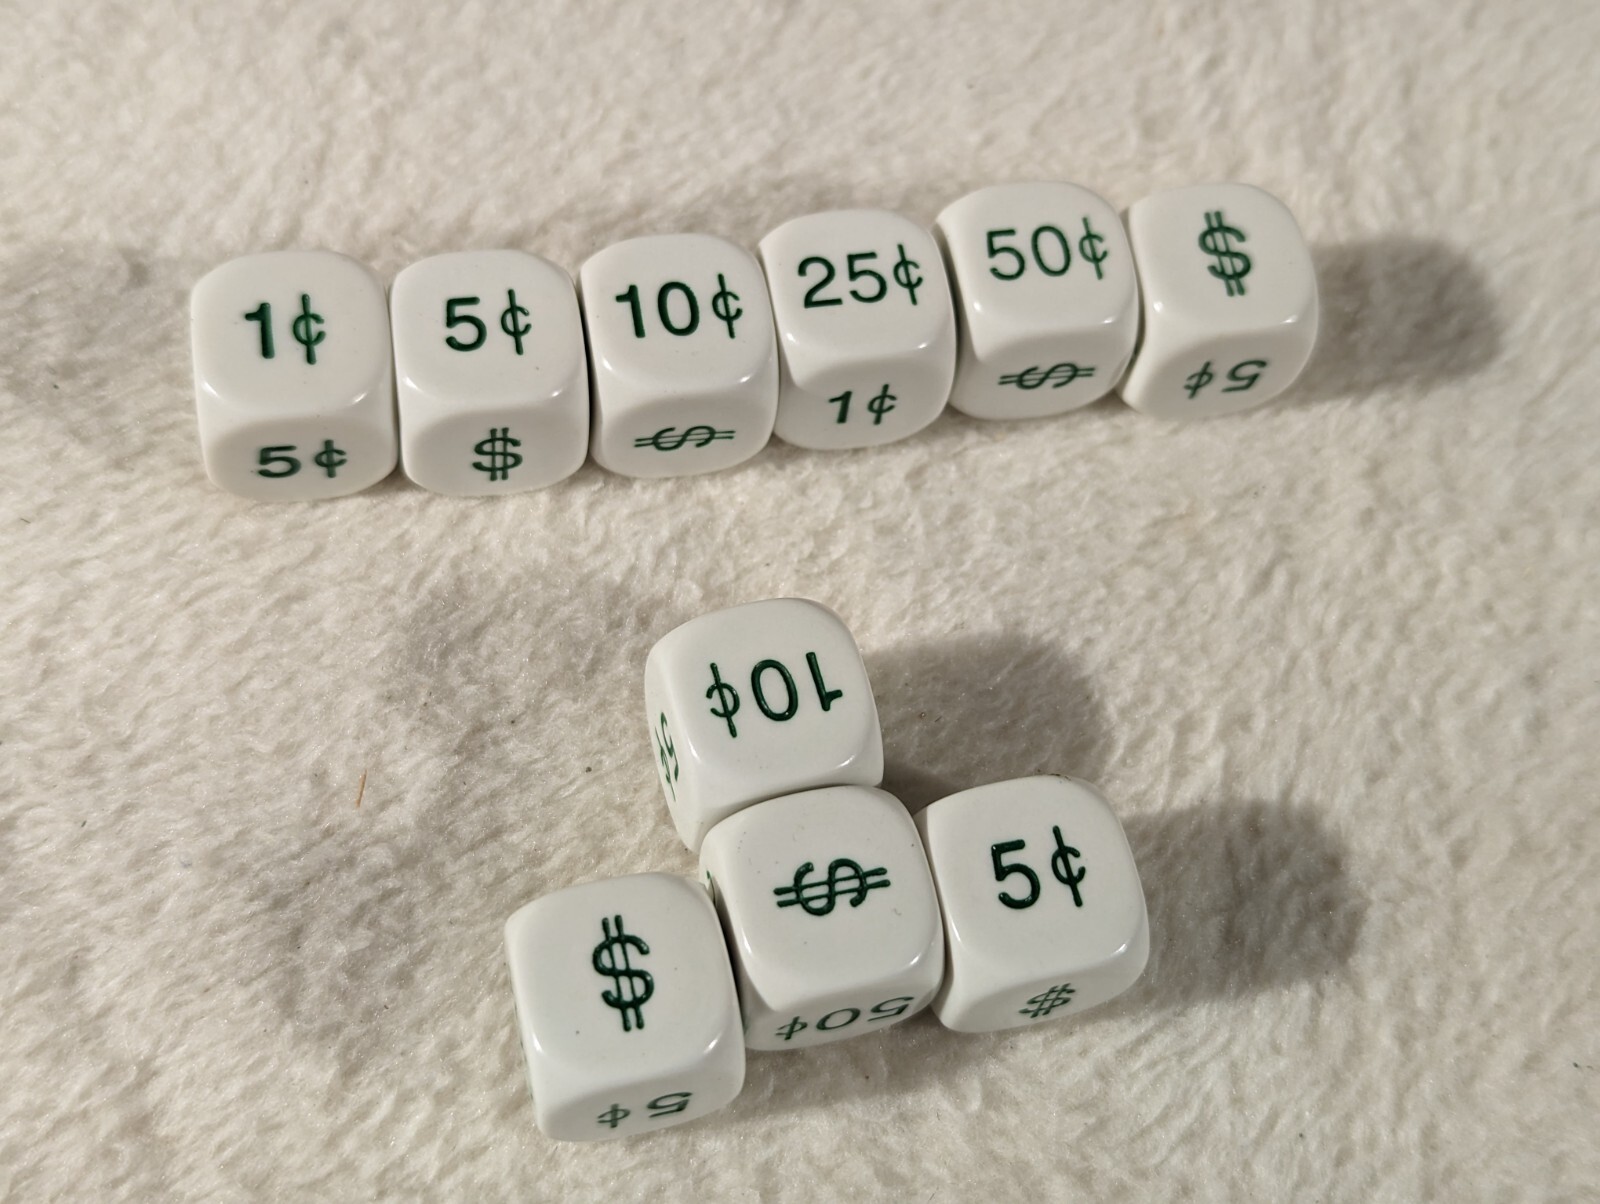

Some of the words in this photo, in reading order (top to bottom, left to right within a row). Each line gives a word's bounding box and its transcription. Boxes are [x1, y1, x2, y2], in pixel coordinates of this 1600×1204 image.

[796, 242, 925, 310] 25¢
[985, 215, 1110, 282] 50¢
[1196, 210, 1254, 299] $
[243, 292, 327, 366] 1¢
[444, 287, 533, 356] 5¢
[614, 272, 745, 340] 10¢
[828, 383, 899, 427] 1¢
[997, 362, 1097, 390] $
[1183, 358, 1269, 400] 5¢
[257, 438, 348, 479] 5¢
[471, 426, 524, 482] $
[634, 424, 737, 452] $
[703, 650, 845, 740] 10¢
[772, 857, 892, 918] $
[989, 824, 1088, 911] 5¢
[591, 913, 656, 1034] $
[1018, 982, 1077, 1019] $
[775, 996, 916, 1042] 50¢
[596, 1090, 694, 1130] 5¢
